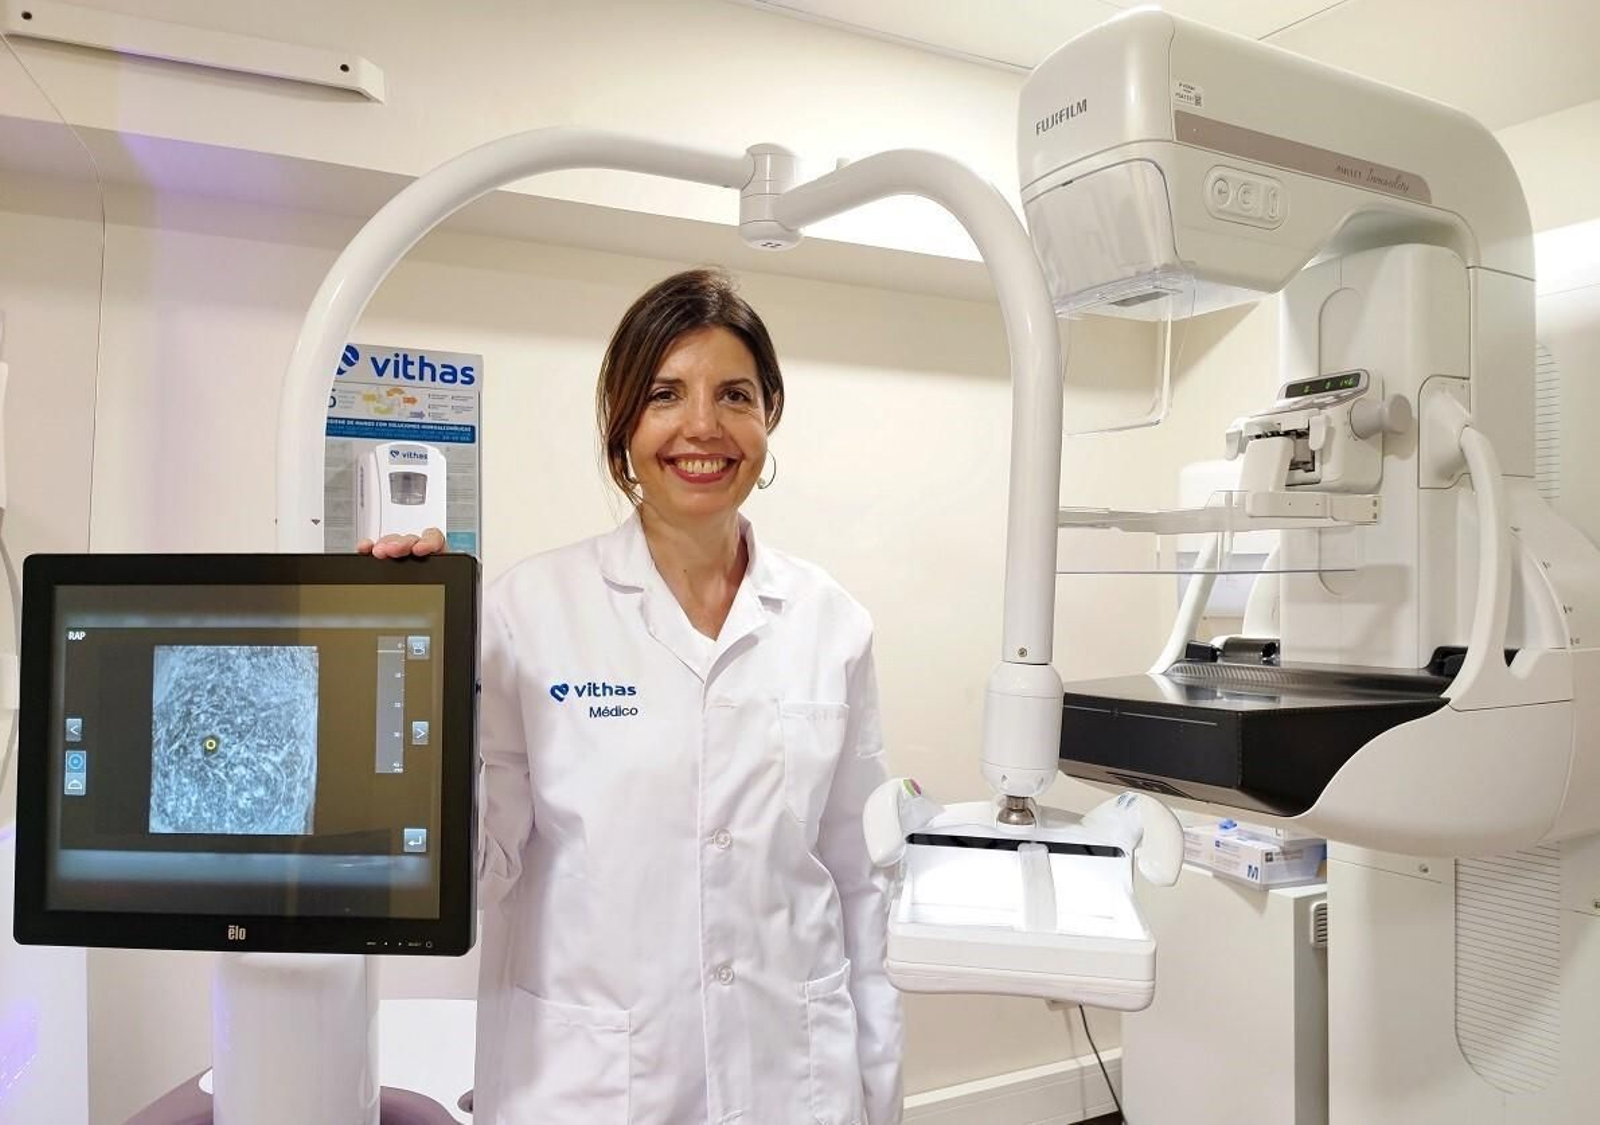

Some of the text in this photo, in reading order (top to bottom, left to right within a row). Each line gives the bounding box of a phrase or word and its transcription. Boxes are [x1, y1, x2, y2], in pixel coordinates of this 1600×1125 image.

[1036, 98, 1087, 135] FUJIFILM
[370, 352, 475, 385] vithas
[401, 451, 428, 460] vithas
[68, 630, 86, 641] RAP
[574, 682, 637, 697] vithas
[589, 705, 638, 719] Médico
